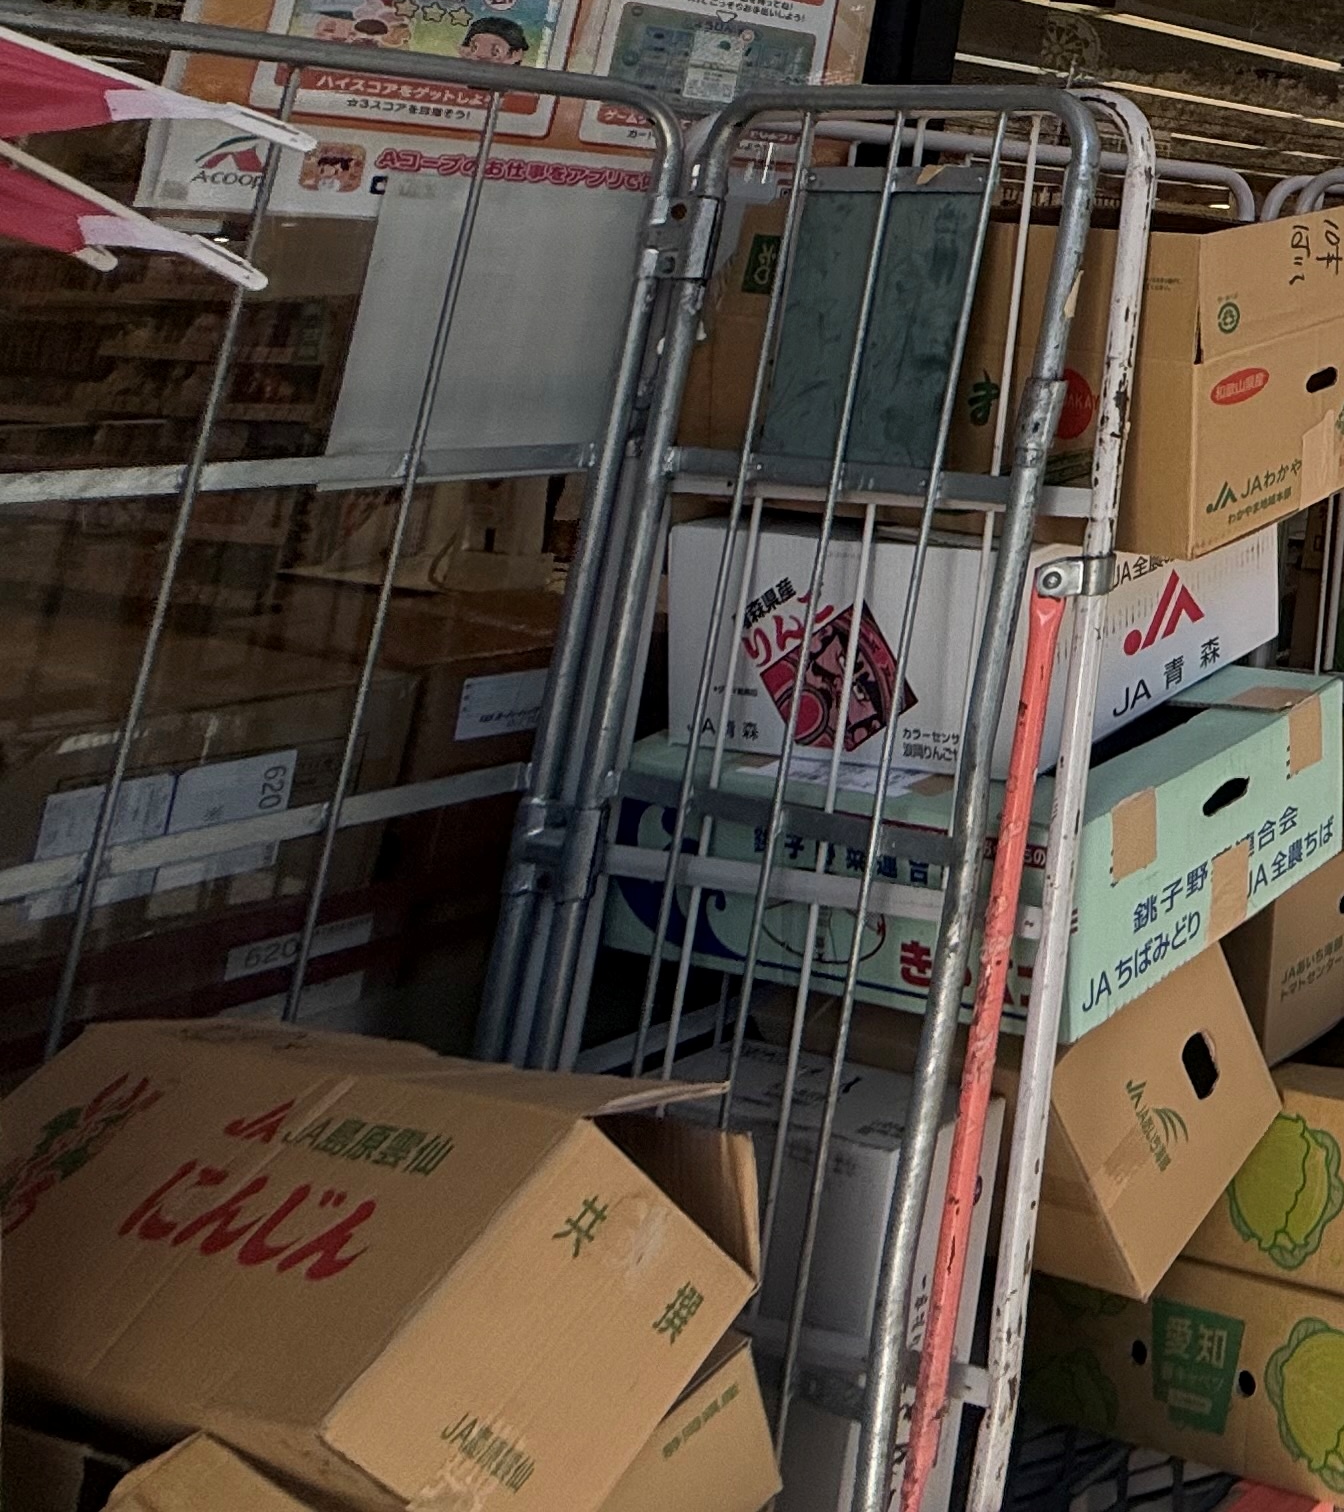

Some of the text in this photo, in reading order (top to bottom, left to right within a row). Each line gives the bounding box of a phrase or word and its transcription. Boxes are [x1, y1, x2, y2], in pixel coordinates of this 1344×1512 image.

[258, 764, 287, 810] 620
[1081, 909, 1202, 1014] JAちばみどり
[117, 1158, 377, 1282] にんじん
[1163, 1316, 1228, 1369] 愛知
